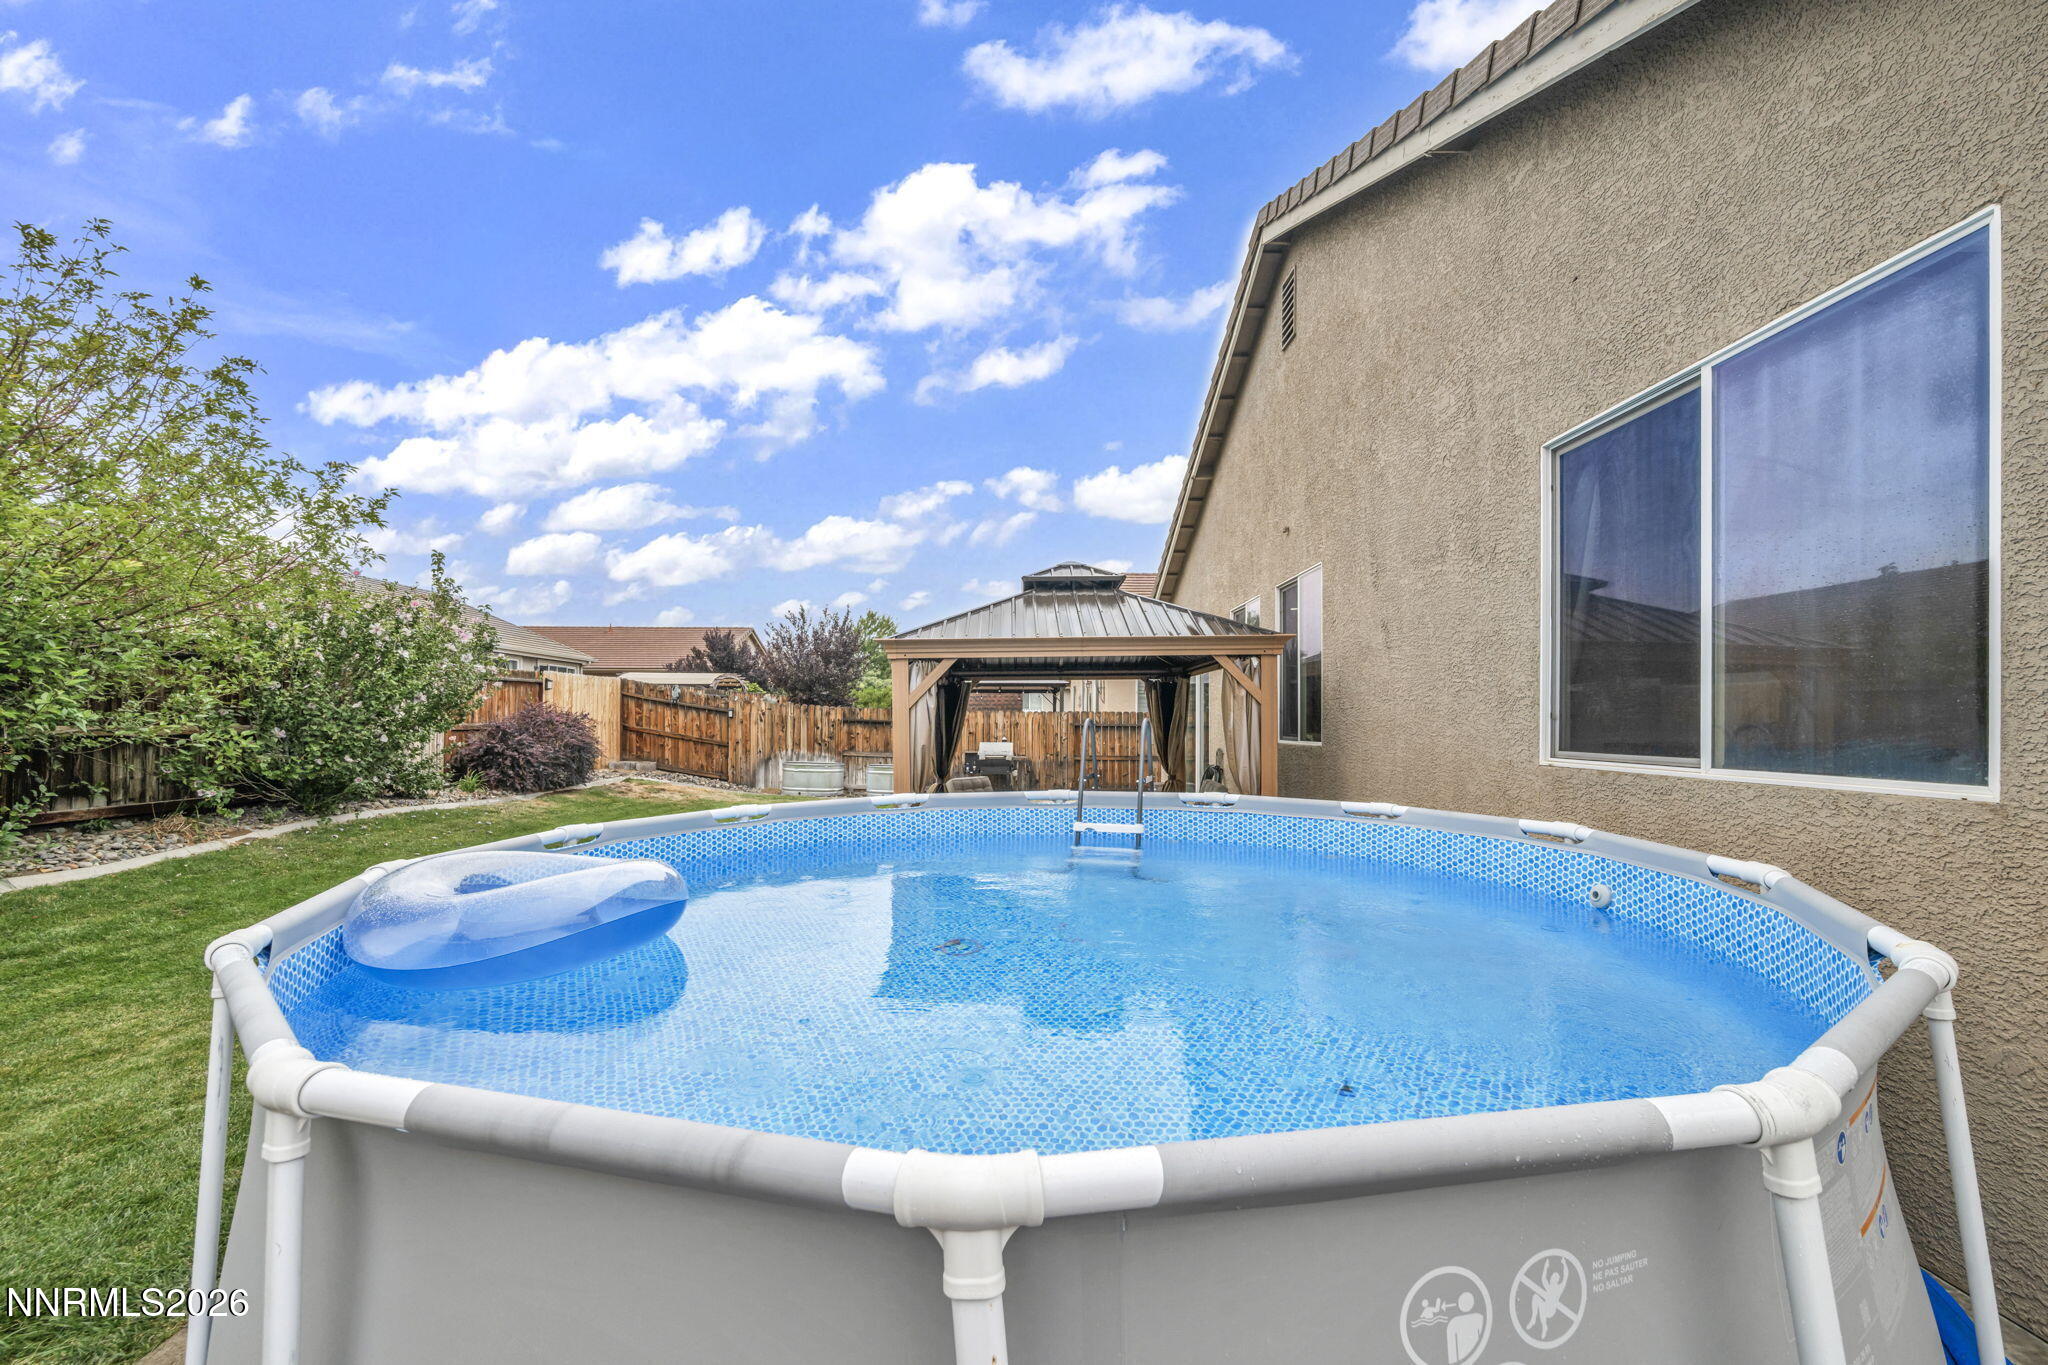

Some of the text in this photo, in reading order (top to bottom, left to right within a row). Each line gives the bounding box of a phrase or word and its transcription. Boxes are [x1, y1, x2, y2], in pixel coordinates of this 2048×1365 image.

[1593, 1250, 1637, 1270] NO JUMPING
[1593, 1257, 1648, 1281] NE PAS SAUTER
[1593, 1274, 1633, 1294] NO SALTAR
